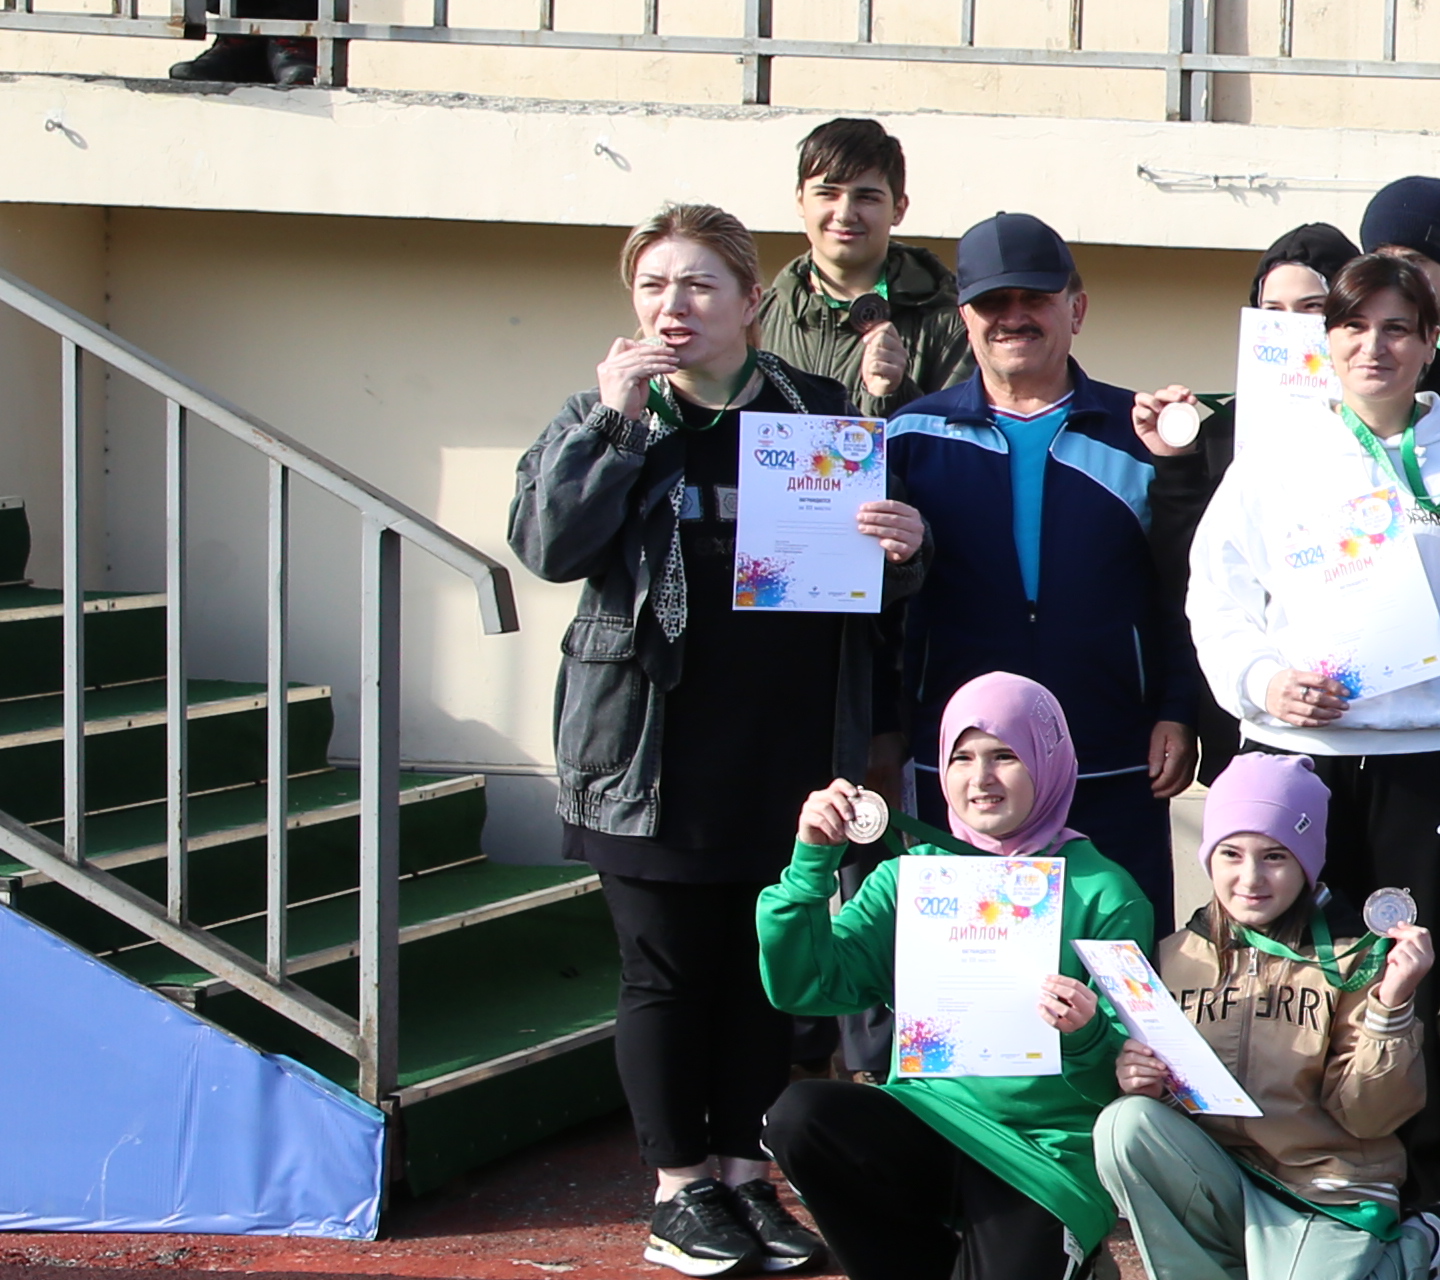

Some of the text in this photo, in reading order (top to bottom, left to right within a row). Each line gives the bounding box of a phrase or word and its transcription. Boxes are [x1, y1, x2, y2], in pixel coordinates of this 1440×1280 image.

[1259, 345, 1288, 363] 2024
[1280, 372, 1328, 389] ДИПЛОМ
[761, 449, 796, 468] 2024
[787, 475, 841, 491] ДИПЛОМ
[1291, 545, 1325, 569] 2024
[1324, 556, 1374, 583] ДИПЛОМ
[920, 897, 959, 917] 2024
[949, 923, 1008, 942] ДИПЛОМ
